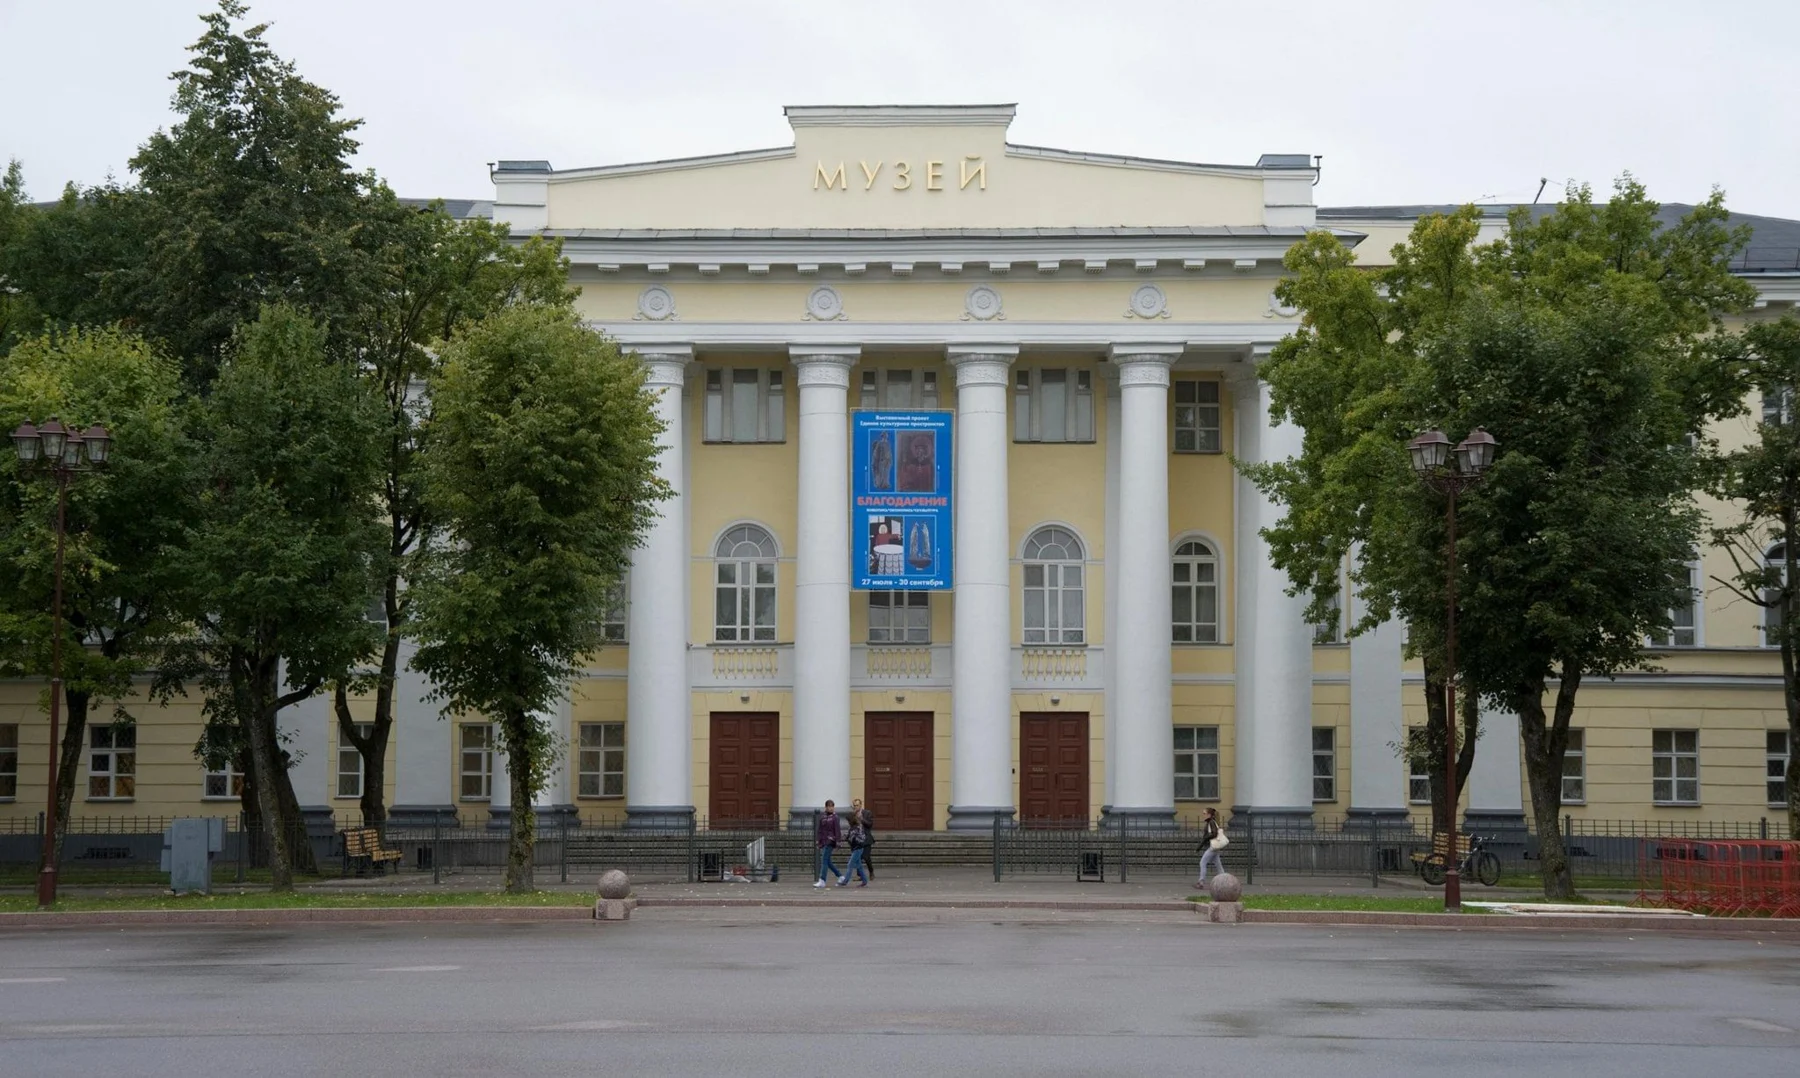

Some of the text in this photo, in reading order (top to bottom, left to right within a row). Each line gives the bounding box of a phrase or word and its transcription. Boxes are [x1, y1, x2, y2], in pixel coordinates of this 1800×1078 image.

[813, 153, 987, 191] МУЗЕЙ
[857, 496, 948, 507] БЛАГОДАРЕНИЕ
[909, 579, 943, 587] сентября
